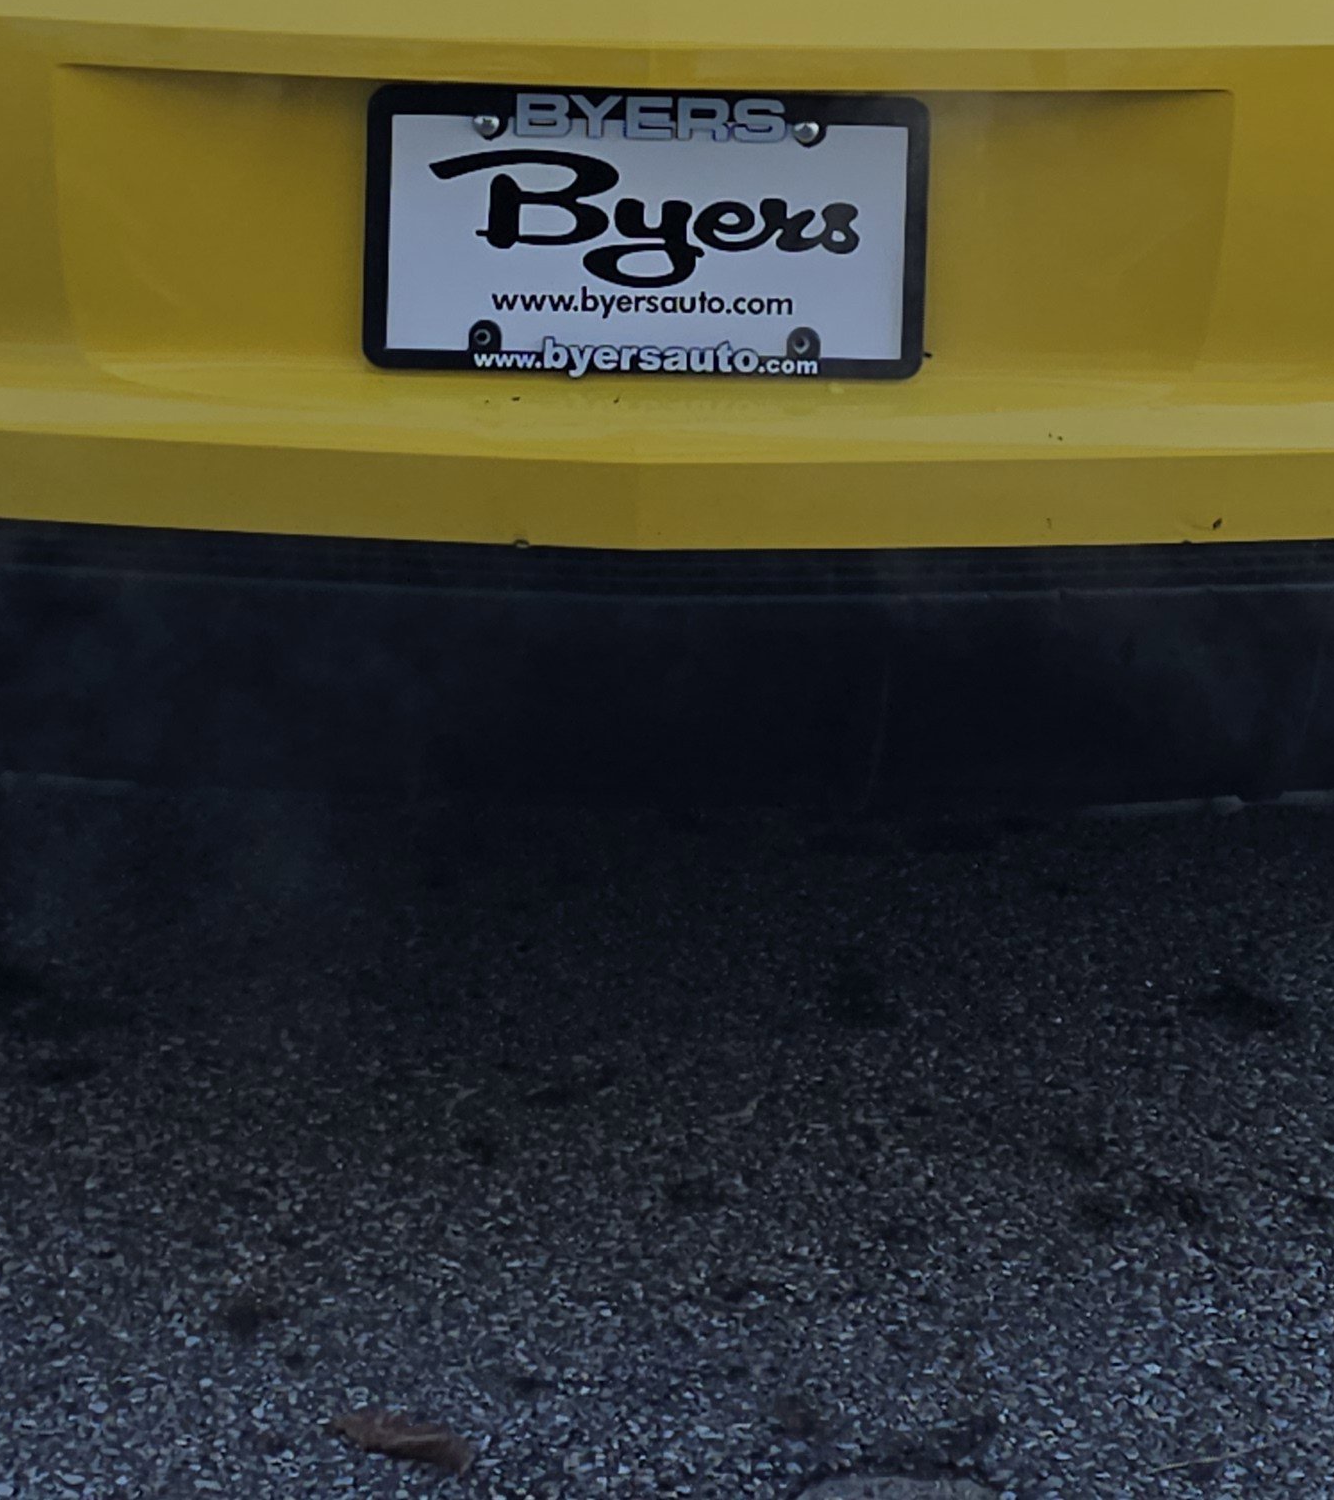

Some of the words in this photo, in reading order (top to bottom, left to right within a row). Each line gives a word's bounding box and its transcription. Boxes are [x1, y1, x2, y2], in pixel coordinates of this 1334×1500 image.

[513, 92, 789, 143] BYERS
[429, 148, 860, 288] Byers
[492, 286, 793, 319] www.byersauto.com
[473, 336, 819, 379] www.byersauto.com
